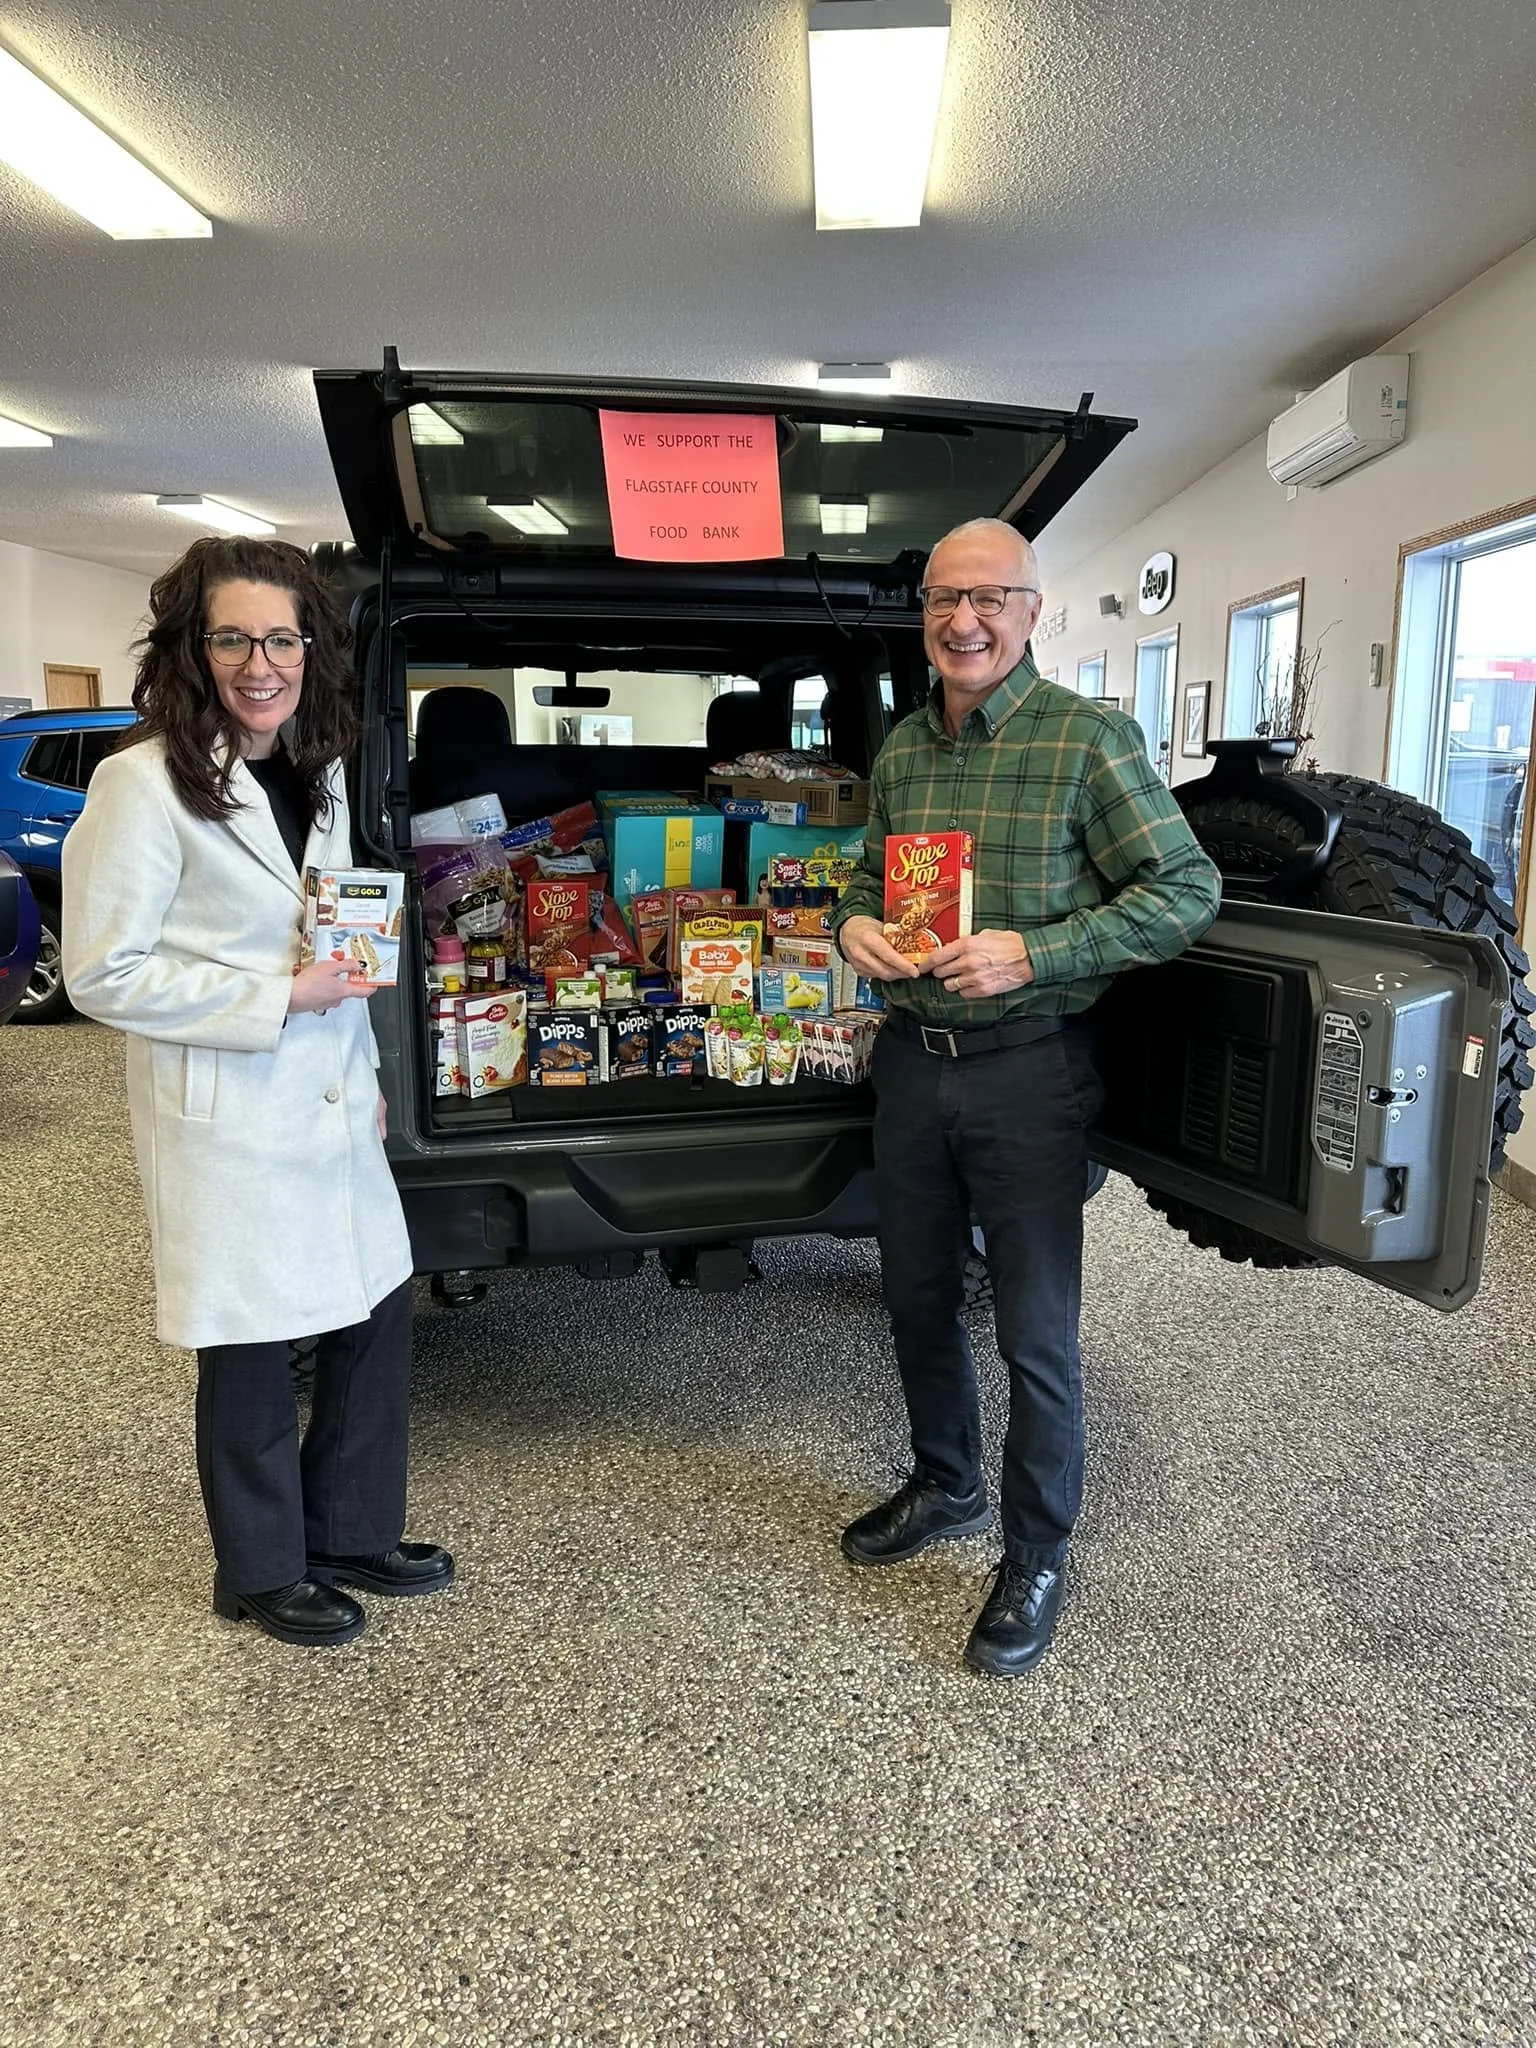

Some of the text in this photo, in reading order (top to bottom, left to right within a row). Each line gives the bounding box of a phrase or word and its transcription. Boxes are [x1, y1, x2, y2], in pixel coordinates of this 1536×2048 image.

[624, 434, 753, 448] WE SUPPORT THE
[625, 479, 758, 493] FLAGSTAFF COUNTY
[650, 526, 740, 539] FOOD BANK
[1142, 567, 1169, 600] Jeep
[724, 802, 760, 815] Crest
[675, 840, 685, 848] 5
[777, 863, 802, 873] Snack
[890, 843, 949, 882] Stove
[910, 864, 940, 890] Top
[533, 889, 579, 917] Stove
[548, 906, 573, 923] Top
[772, 911, 796, 922] Snack
[694, 919, 729, 929] OLD EL PASO
[699, 951, 729, 960] Baby
[779, 953, 799, 965] NUTRI
[1325, 1027, 1357, 1041] JL
